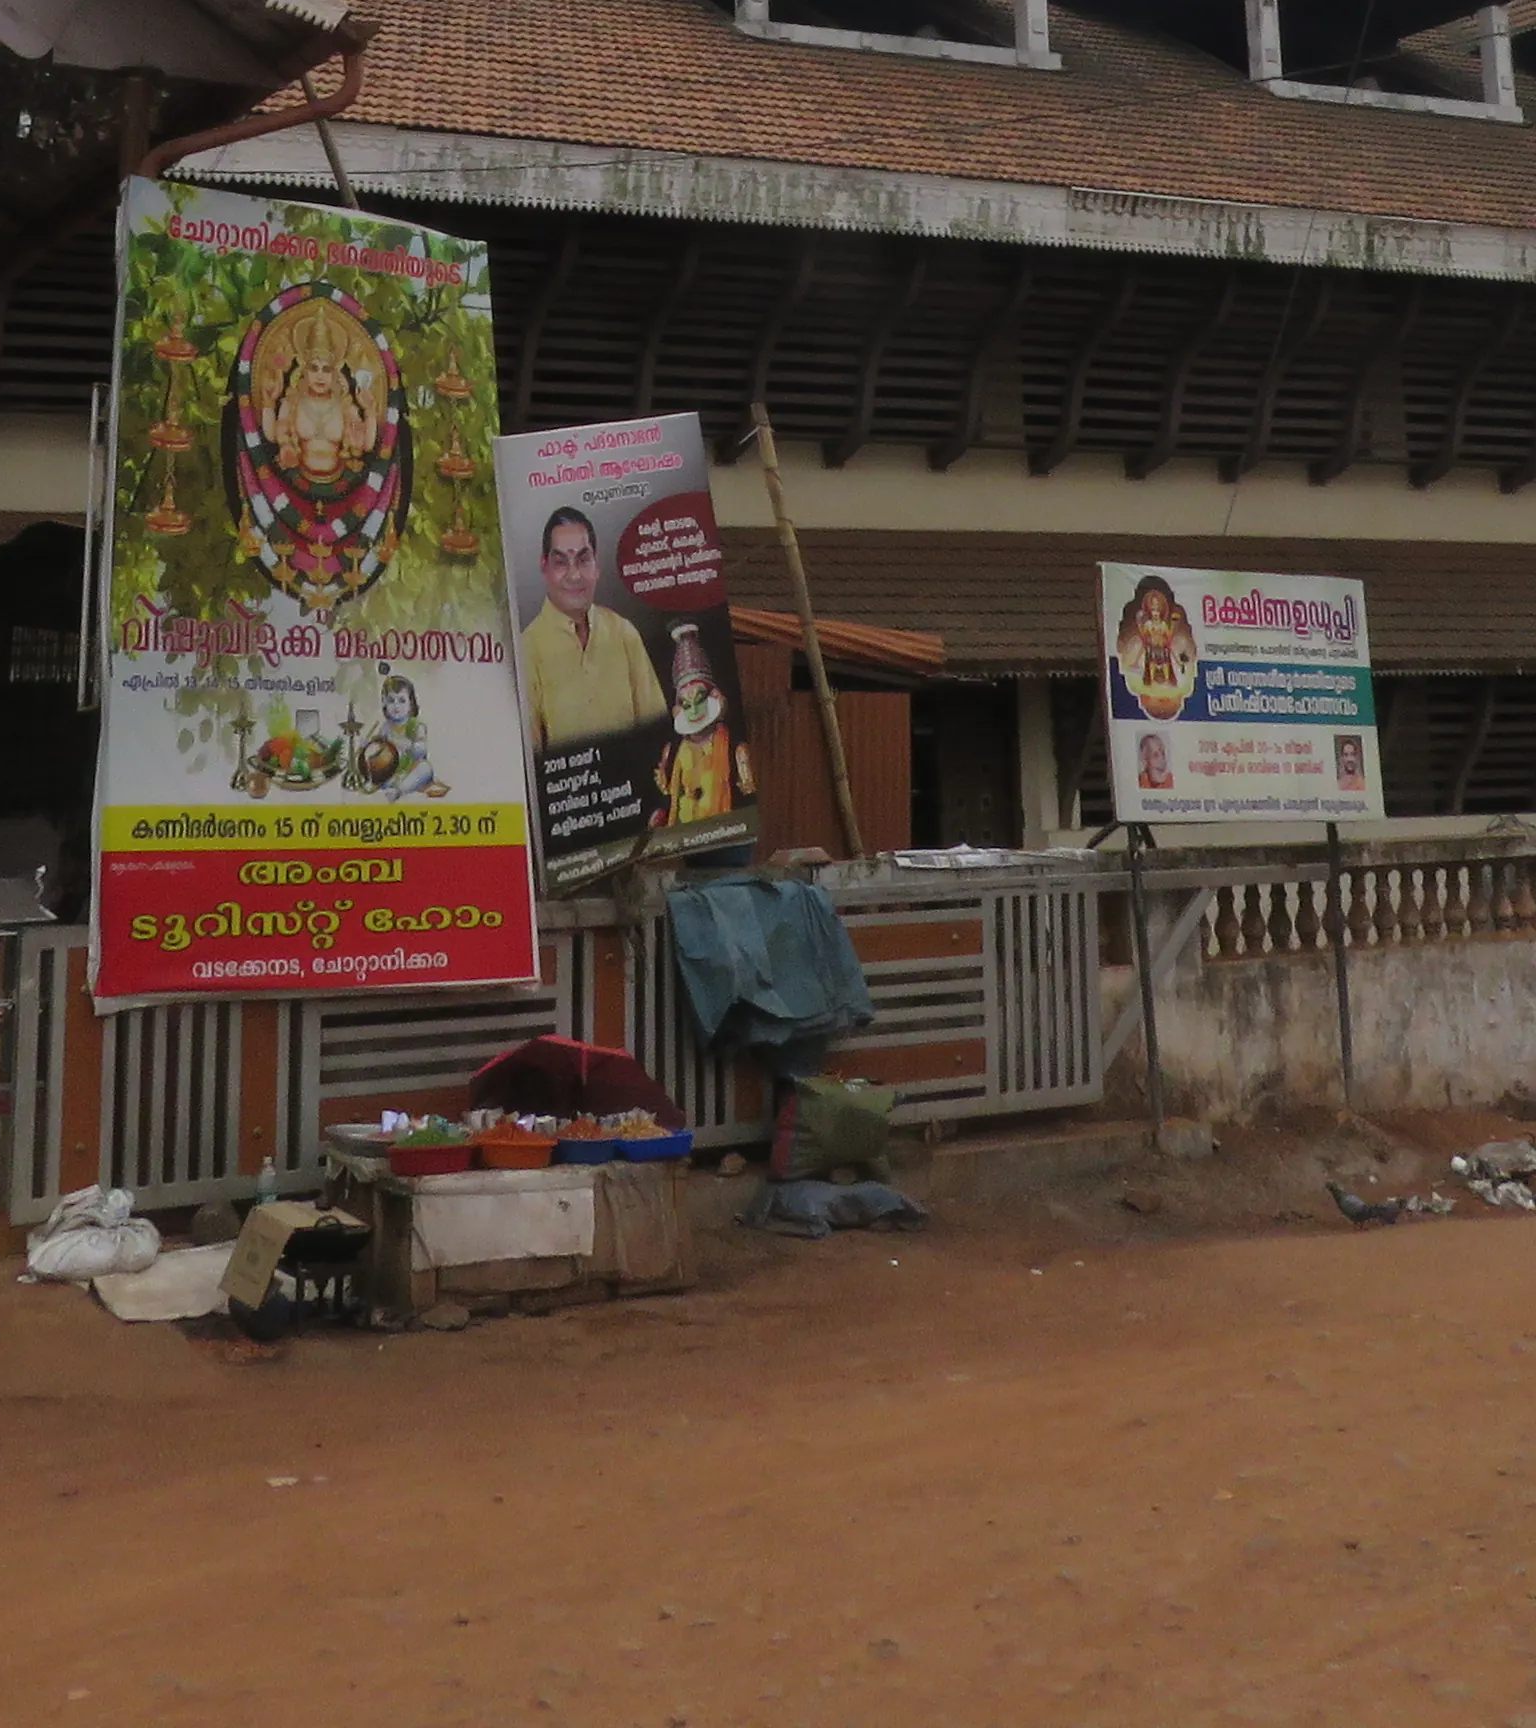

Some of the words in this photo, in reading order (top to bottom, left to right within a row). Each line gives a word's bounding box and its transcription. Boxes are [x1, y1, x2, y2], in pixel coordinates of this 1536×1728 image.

[168, 214, 320, 261] ചോറ്റാനിക്കര
[327, 241, 463, 288] ഭഗവതിയുടെ
[333, 627, 505, 664] മഹോത്സവം
[122, 673, 180, 691] ഏപ്രിൽ
[131, 813, 266, 838] കണിദർശനം
[275, 817, 293, 837] 15
[301, 812, 324, 837] ന്
[328, 810, 428, 842] വെളുപ്പിന്
[432, 816, 471, 835] 2.30
[478, 811, 499, 835] ന്
[239, 858, 403, 885] അംബ
[130, 900, 354, 951] ടൂറിസ്റ്റ്
[364, 904, 504, 934] ഹോം
[192, 958, 305, 978] വടക്കേനട,
[312, 947, 448, 982] ചോറ്റാനിക്കര
